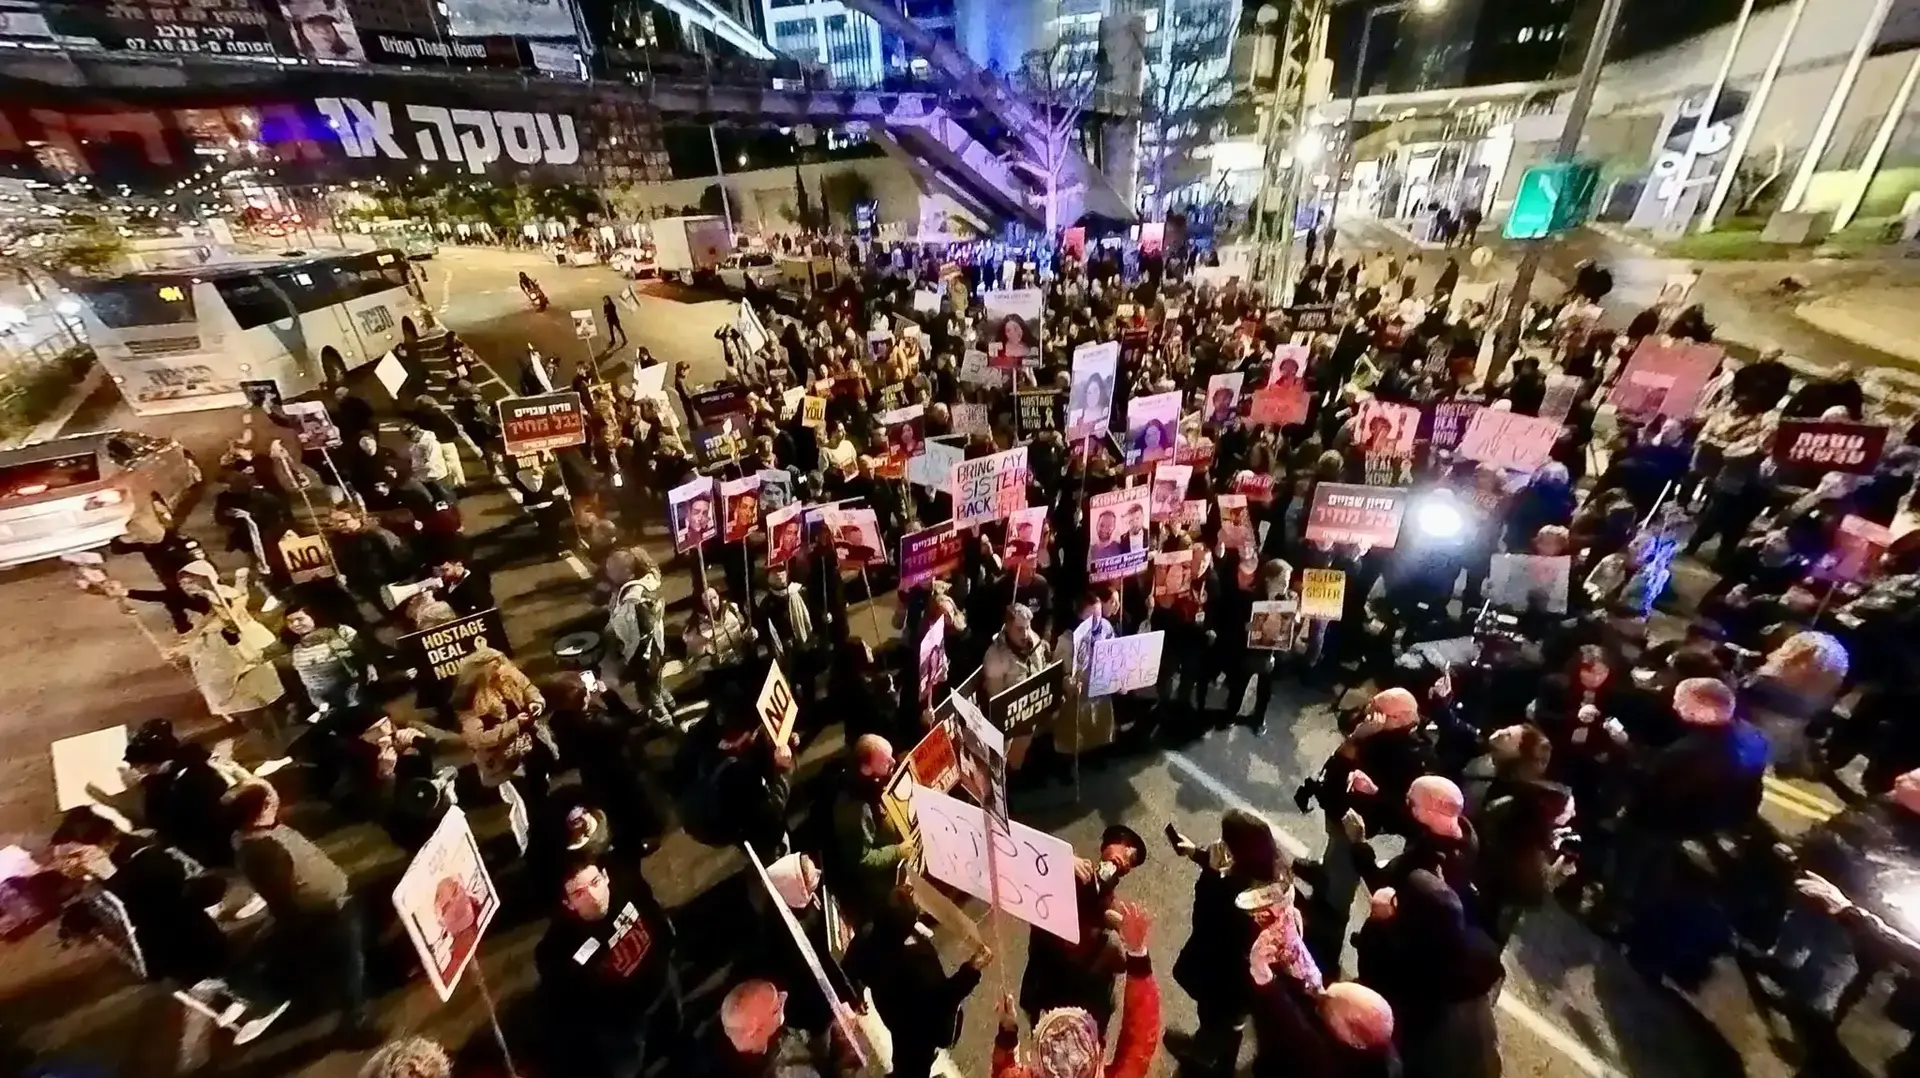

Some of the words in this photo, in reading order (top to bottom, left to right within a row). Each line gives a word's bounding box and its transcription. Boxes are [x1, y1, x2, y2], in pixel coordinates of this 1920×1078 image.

[379, 35, 417, 58] Bring
[415, 37, 453, 57] Them
[452, 40, 487, 58] Home
[314, 97, 408, 160] או
[405, 104, 579, 174] עסקה
[508, 418, 549, 435] מחיר
[805, 406, 823, 420] YOU
[957, 459, 995, 483] BRING
[1001, 451, 1023, 469] MY
[961, 467, 1026, 500] SISTER
[956, 497, 992, 522] BACK
[287, 545, 322, 572] NO
[421, 618, 487, 650] HOSTAGE
[427, 642, 467, 665] DEAL
[765, 679, 789, 737] NO
